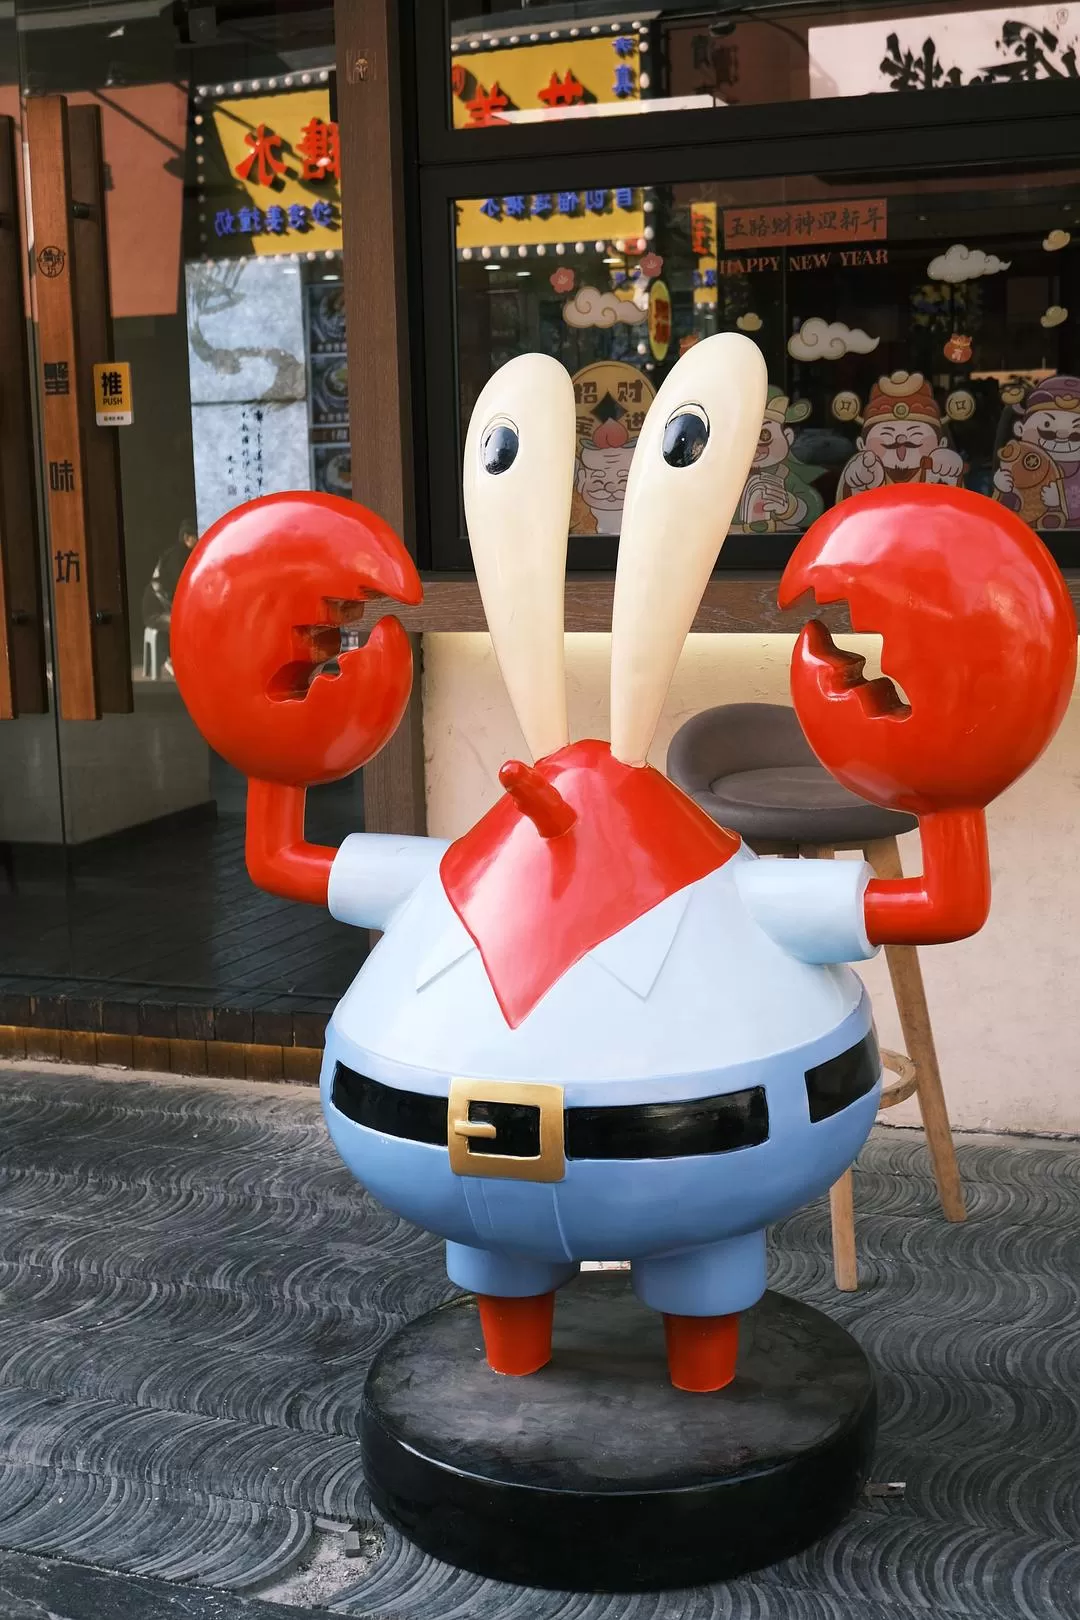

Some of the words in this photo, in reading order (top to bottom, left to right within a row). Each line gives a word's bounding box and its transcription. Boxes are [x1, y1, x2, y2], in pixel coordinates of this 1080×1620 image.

[721, 257, 779, 274] HAPPY
[790, 253, 831, 272] NEW
[840, 250, 888, 267] YEAR
[101, 371, 123, 396] 推
[102, 396, 123, 406] PUSH
